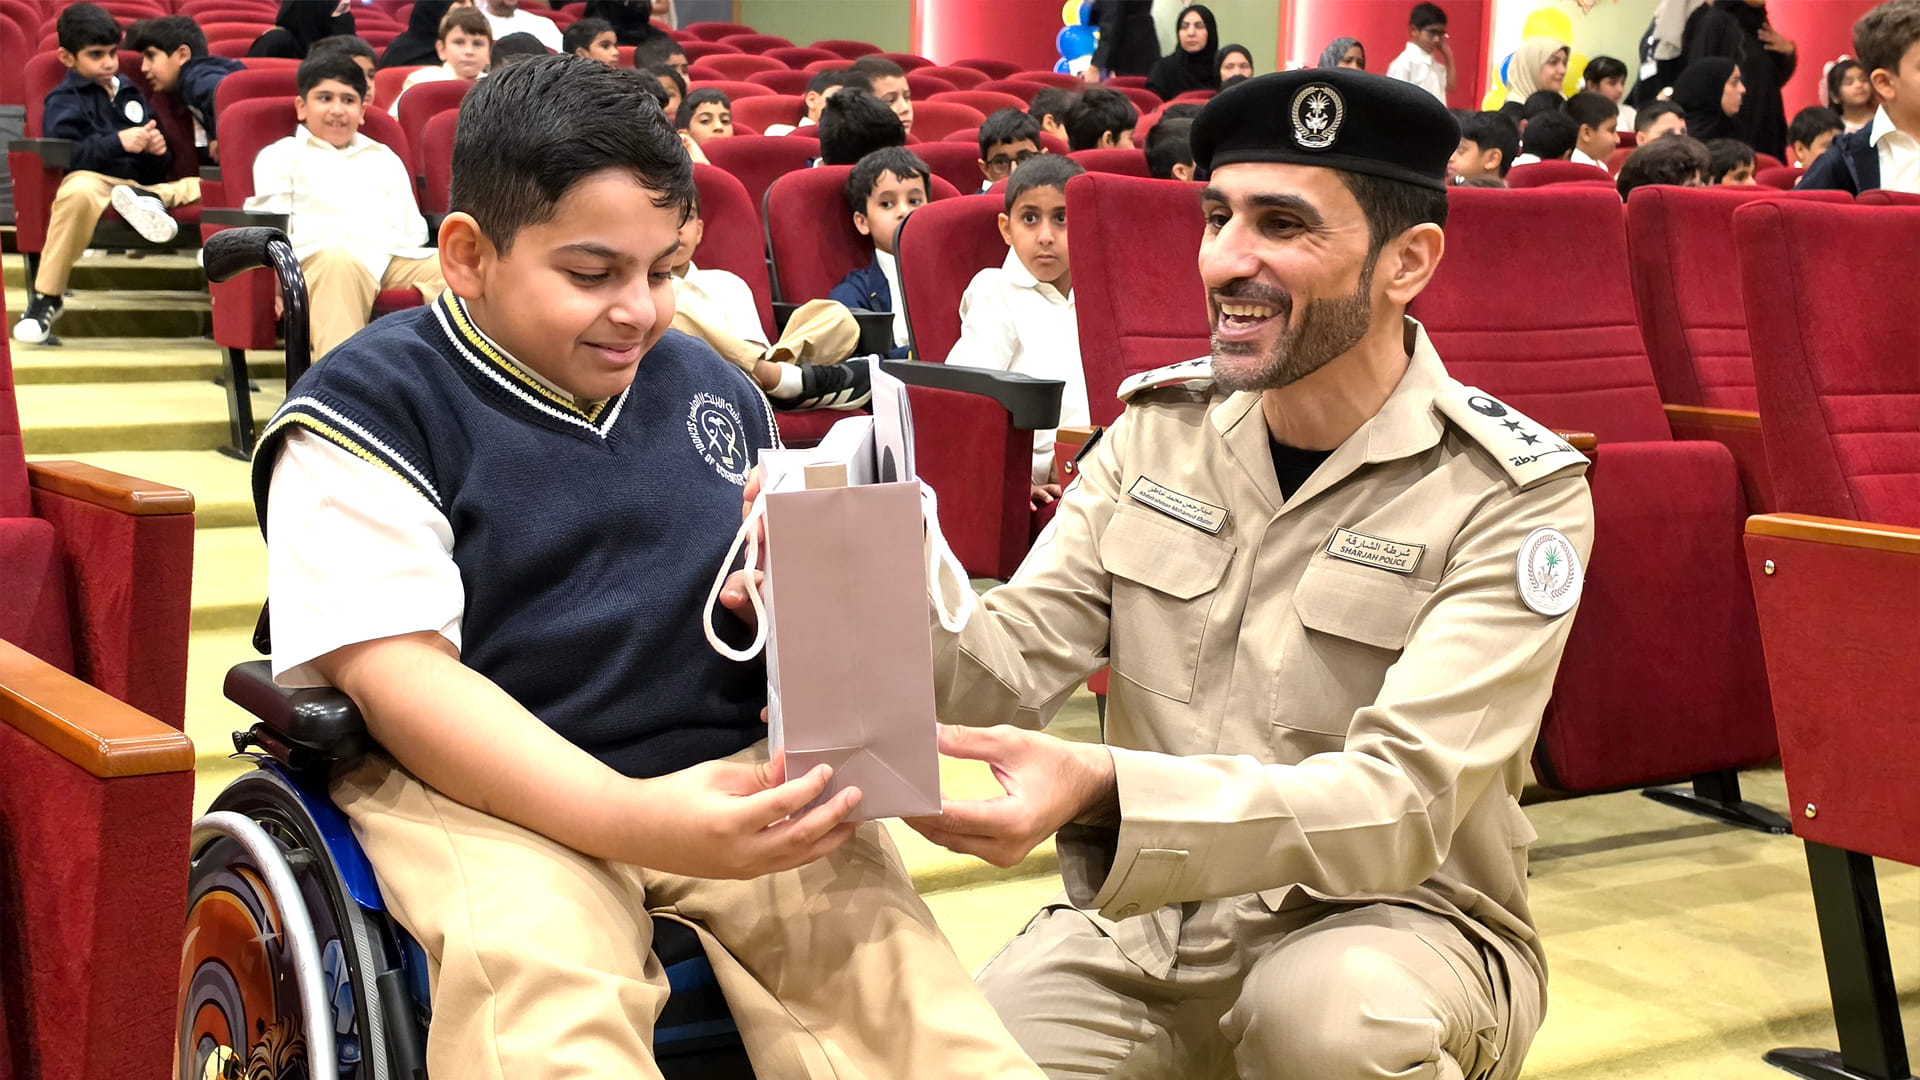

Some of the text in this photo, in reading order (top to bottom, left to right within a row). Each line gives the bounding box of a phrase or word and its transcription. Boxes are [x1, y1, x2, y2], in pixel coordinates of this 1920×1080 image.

[686, 420, 716, 466] SCHOOL OF
[1509, 444, 1575, 467] الشرطة
[1167, 495, 1182, 504] محمد
[1340, 546, 1407, 567] SHARJAH POLICE
[1345, 534, 1411, 557] شرطة الشارقة
